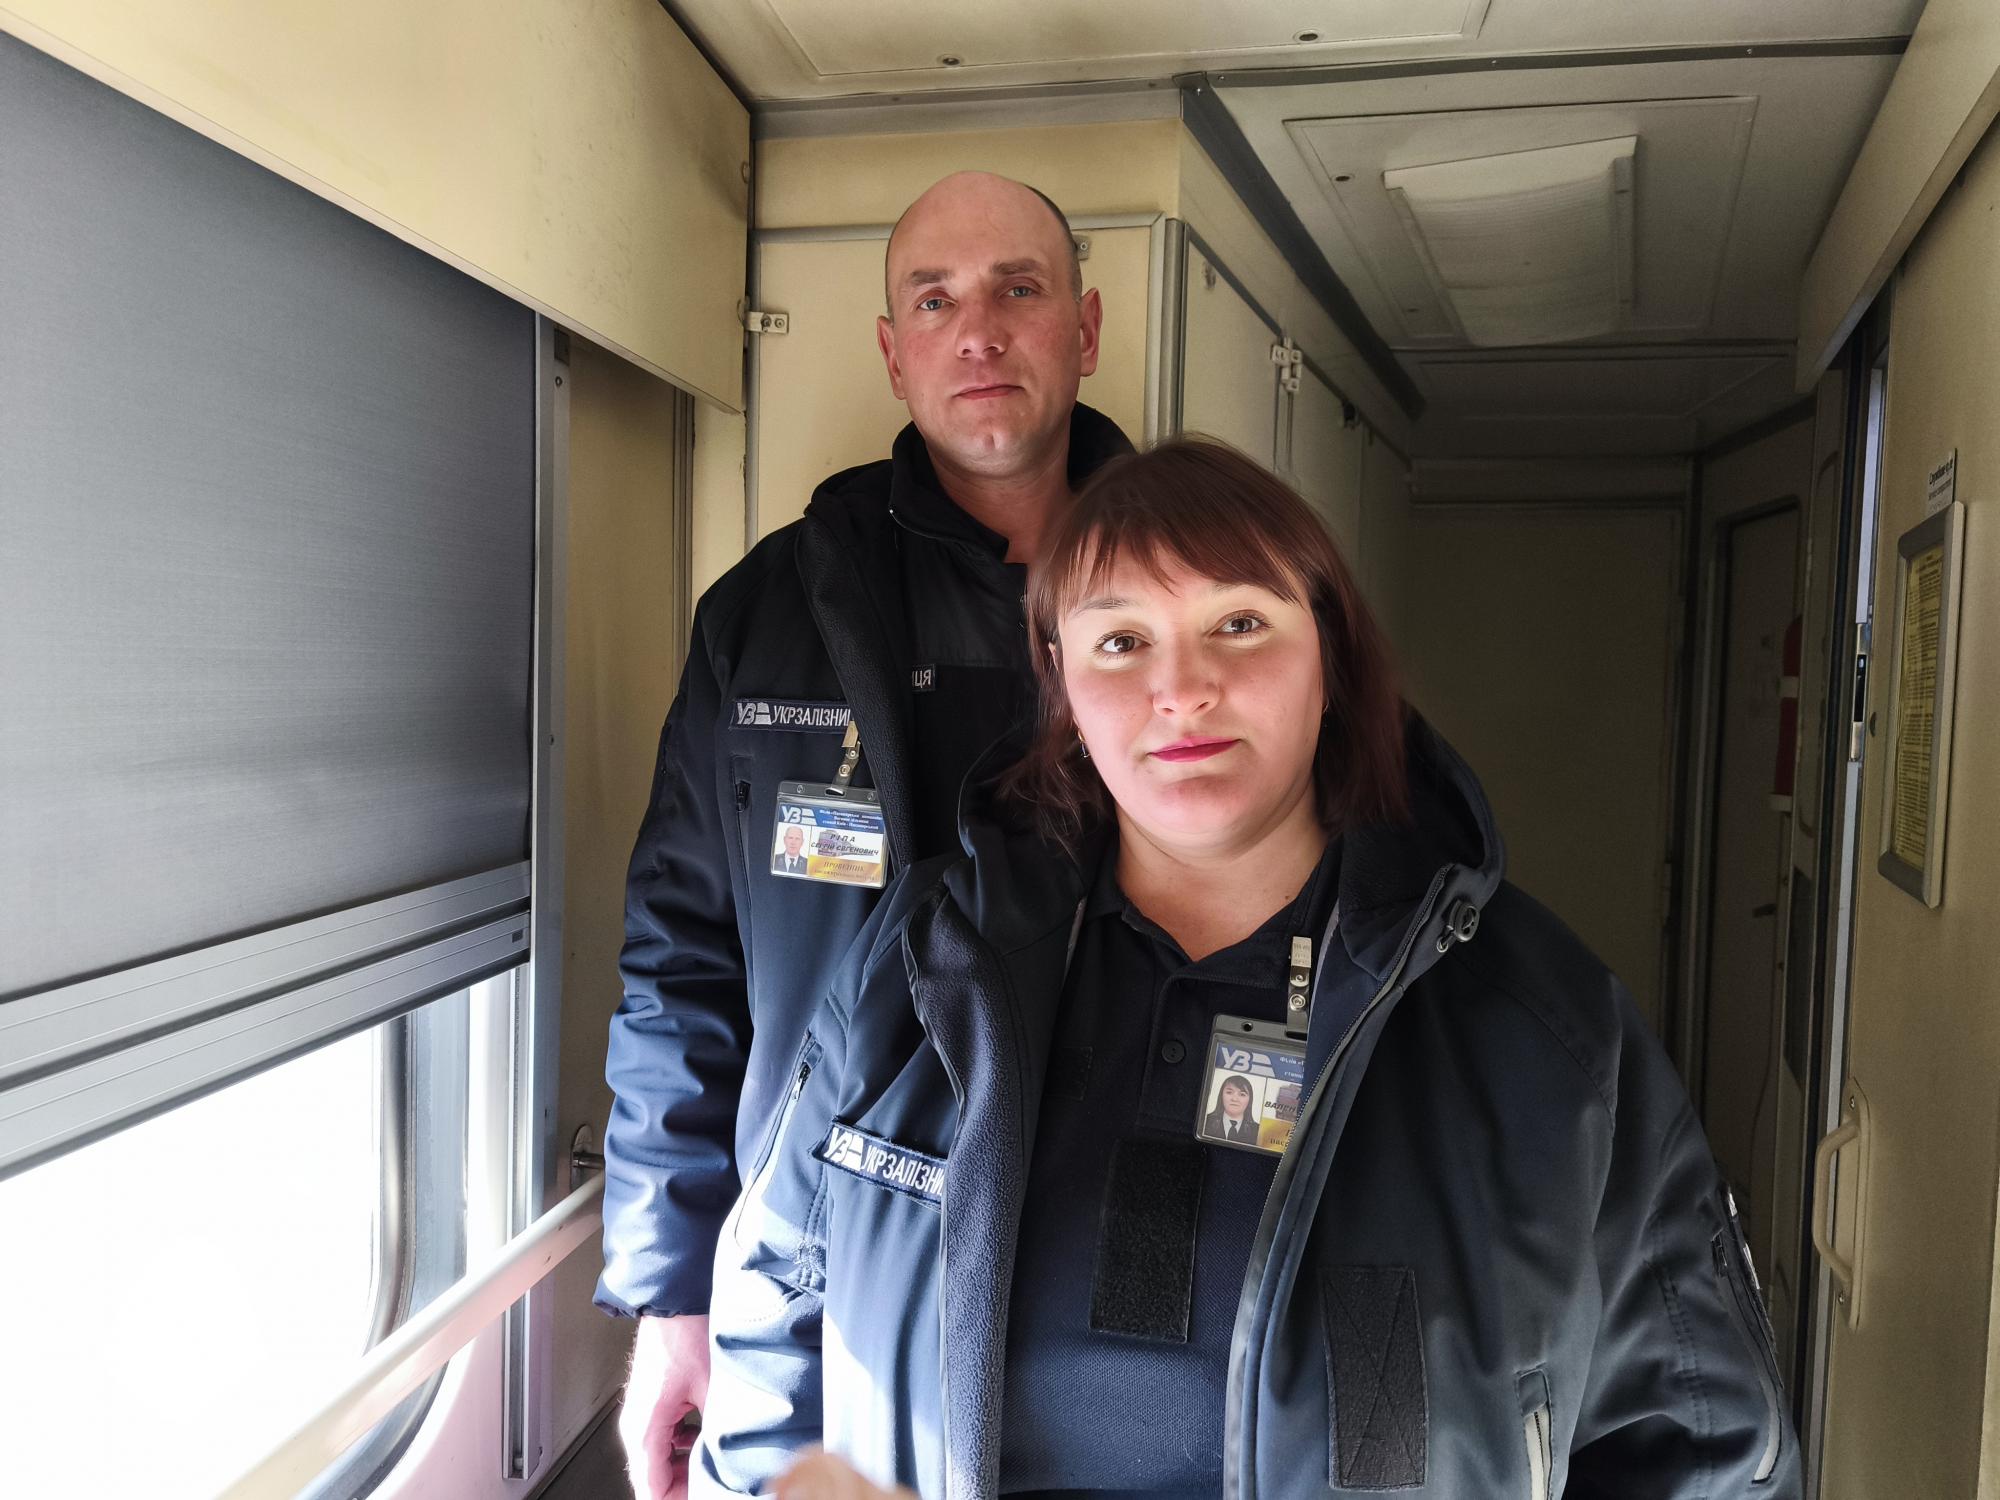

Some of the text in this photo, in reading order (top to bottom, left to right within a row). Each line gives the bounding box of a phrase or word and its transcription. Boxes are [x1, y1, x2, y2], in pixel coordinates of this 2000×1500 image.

[911, 669, 932, 688] ЦЯ
[781, 805, 802, 823] УЗ
[1221, 1046, 1251, 1074] УЗ
[860, 1144, 945, 1197] УКРЗАЛІЗНИ
